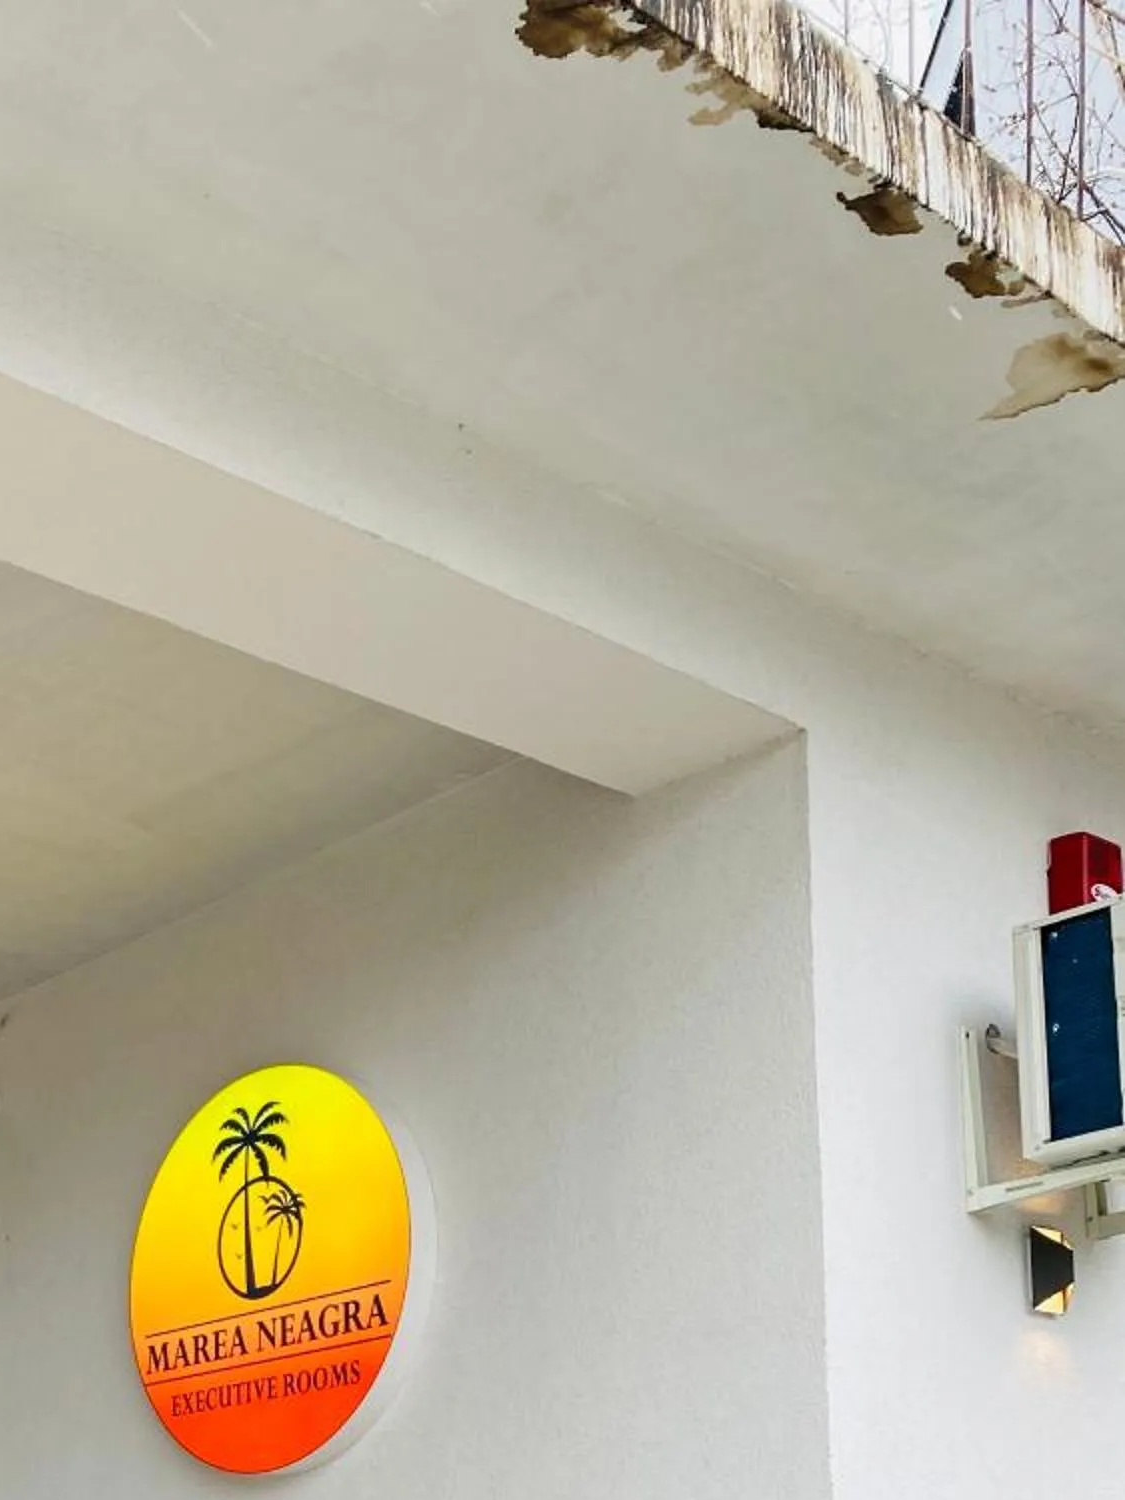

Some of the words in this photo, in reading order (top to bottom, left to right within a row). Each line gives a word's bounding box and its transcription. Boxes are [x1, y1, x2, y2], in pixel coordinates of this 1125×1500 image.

[146, 1325, 248, 1375] MAREA
[256, 1294, 389, 1352] NEAGRA
[171, 1376, 276, 1417] EXECUTIVE
[282, 1359, 361, 1398] ROOMS
